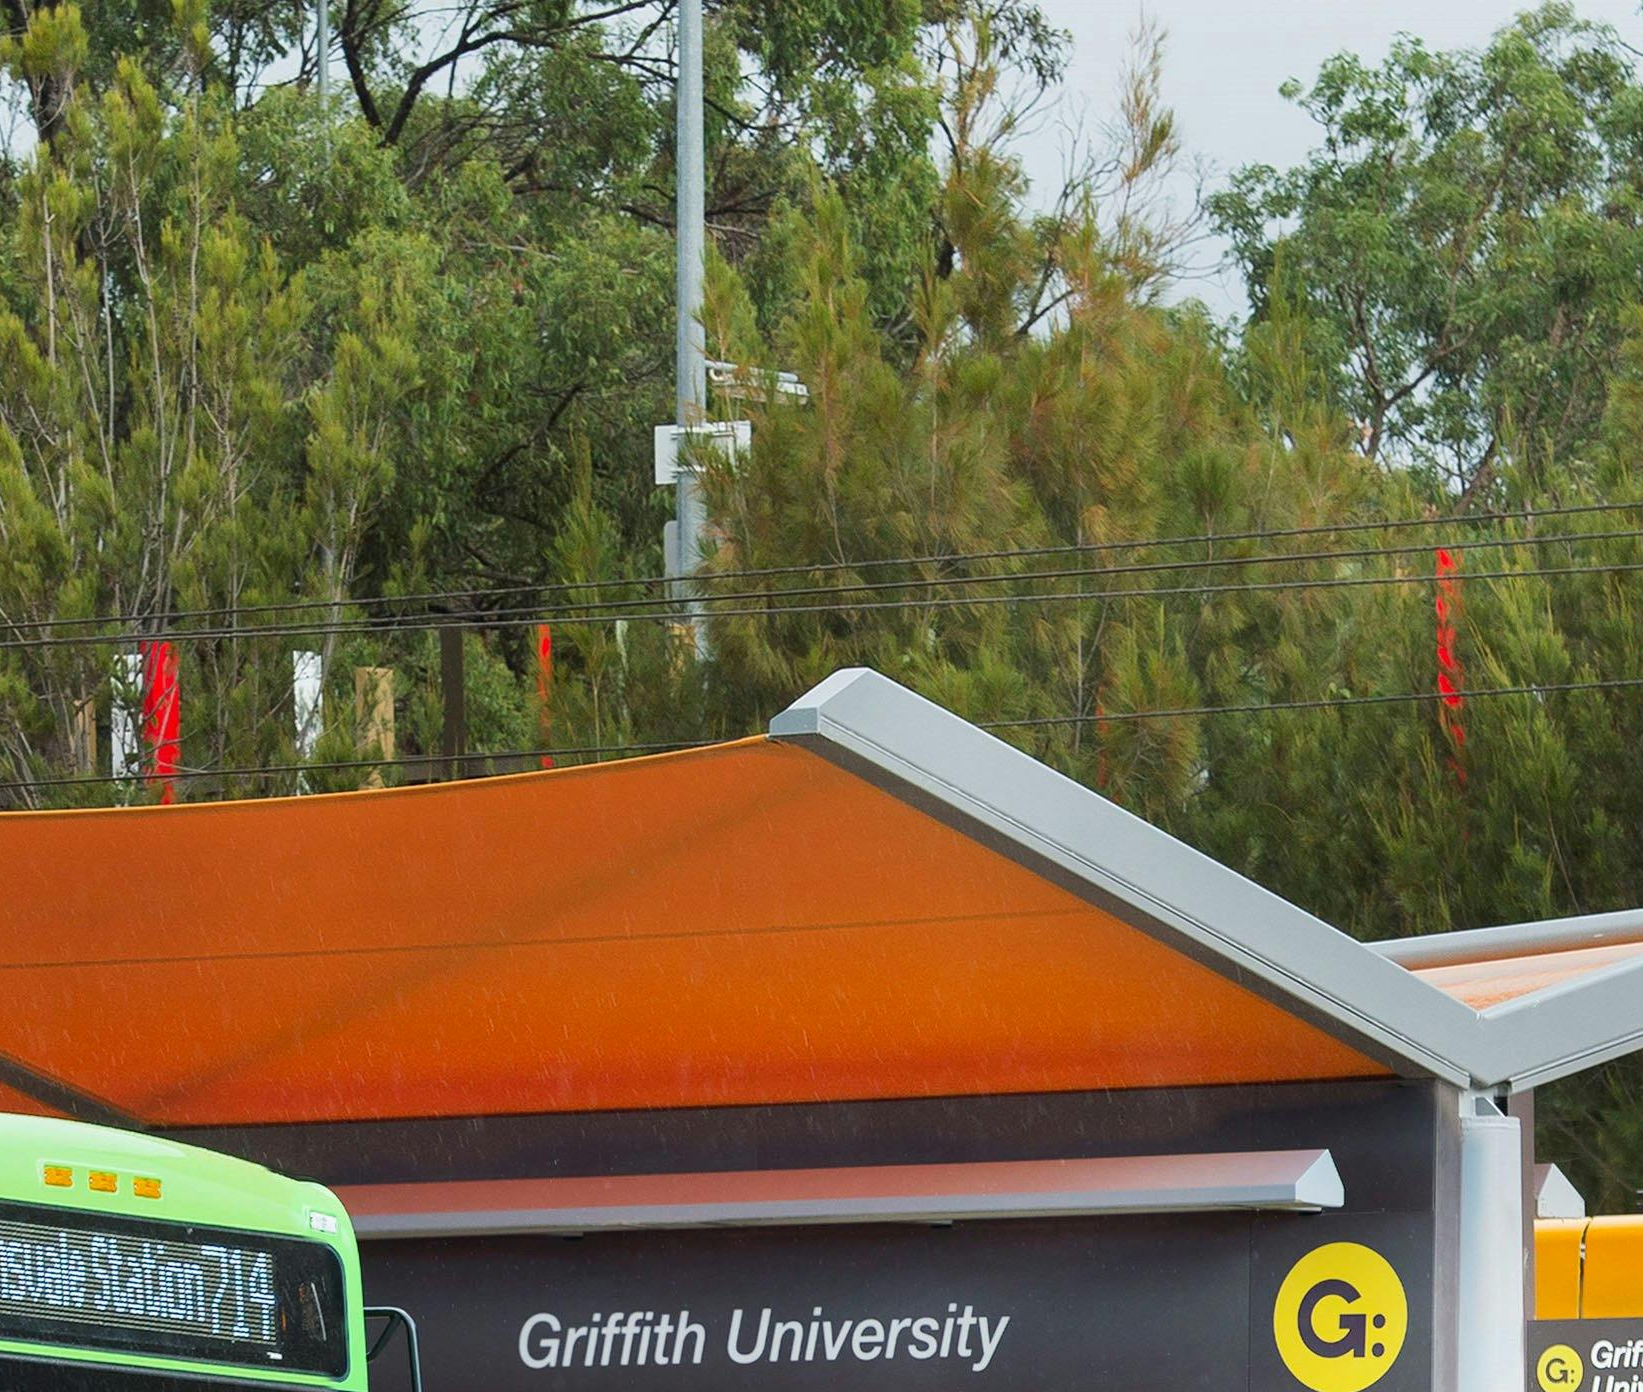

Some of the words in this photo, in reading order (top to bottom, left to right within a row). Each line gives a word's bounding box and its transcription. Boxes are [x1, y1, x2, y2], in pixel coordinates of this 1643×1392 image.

[200, 1243, 278, 1341] 714
[517, 1310, 706, 1370] Griffith
[725, 1302, 1011, 1373] University
